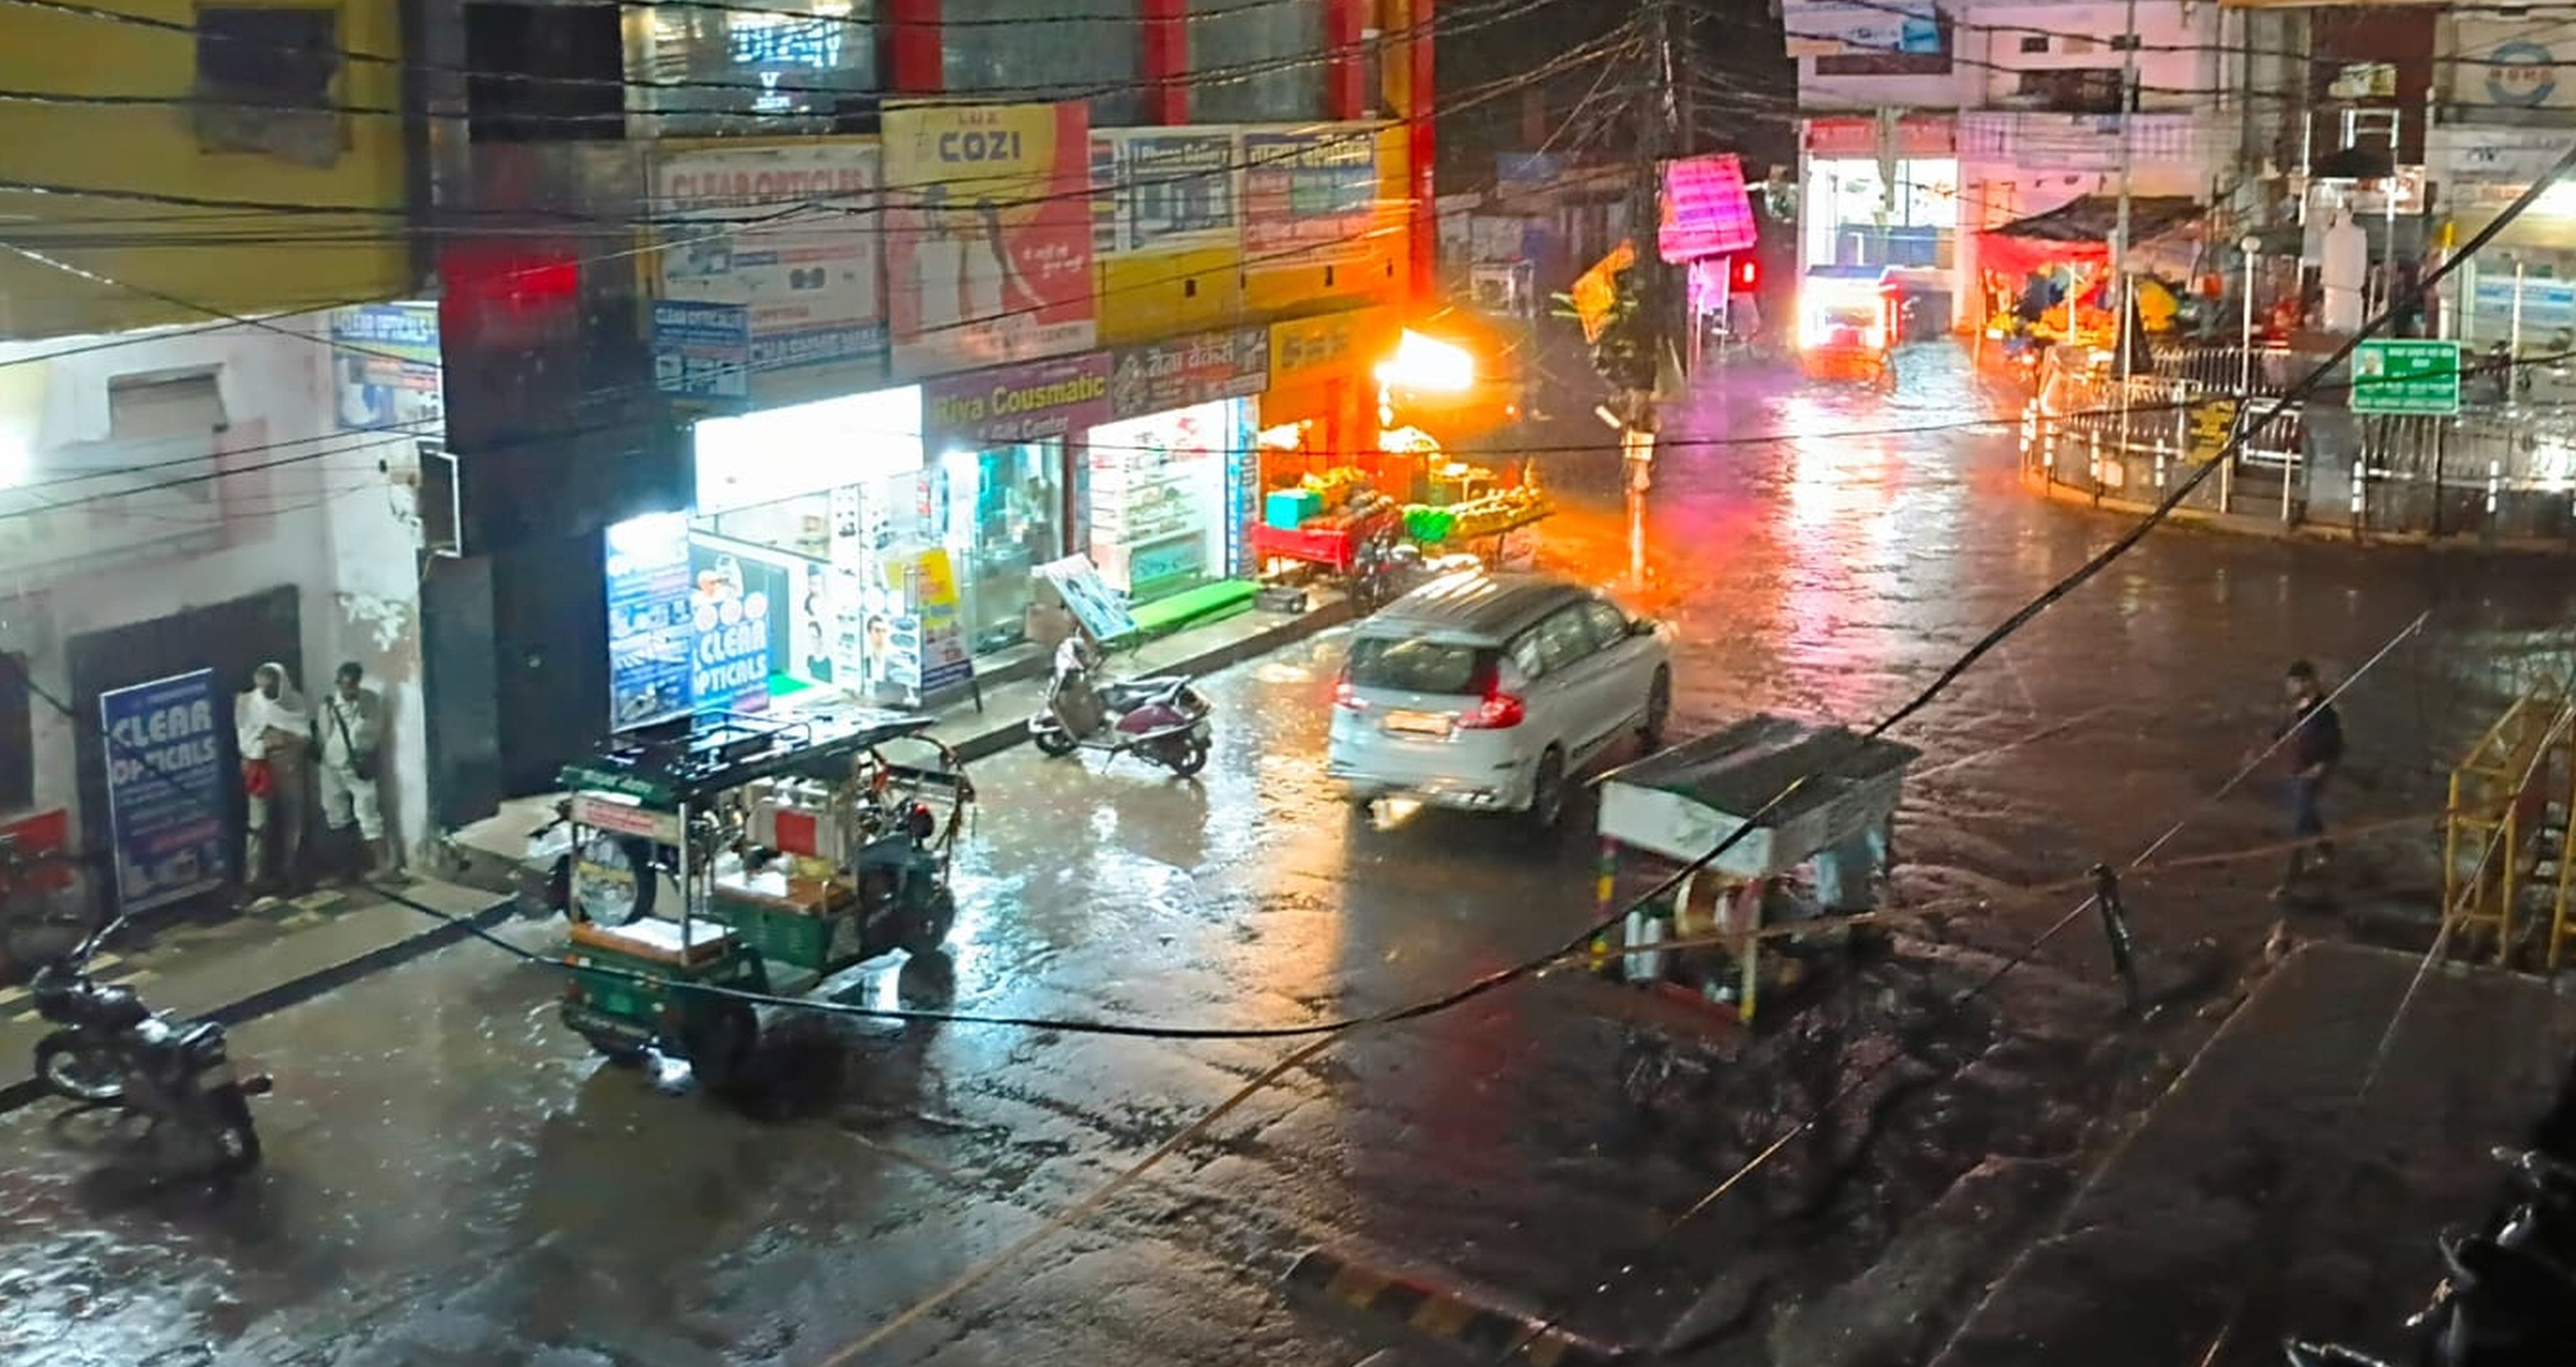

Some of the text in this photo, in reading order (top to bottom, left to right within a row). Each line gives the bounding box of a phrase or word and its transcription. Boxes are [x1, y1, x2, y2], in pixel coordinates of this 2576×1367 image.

[938, 130, 1021, 163] COZI
[992, 374, 1105, 415] Cousmatic
[699, 618, 766, 664] CLEAR
[112, 699, 213, 748] CLEAR
